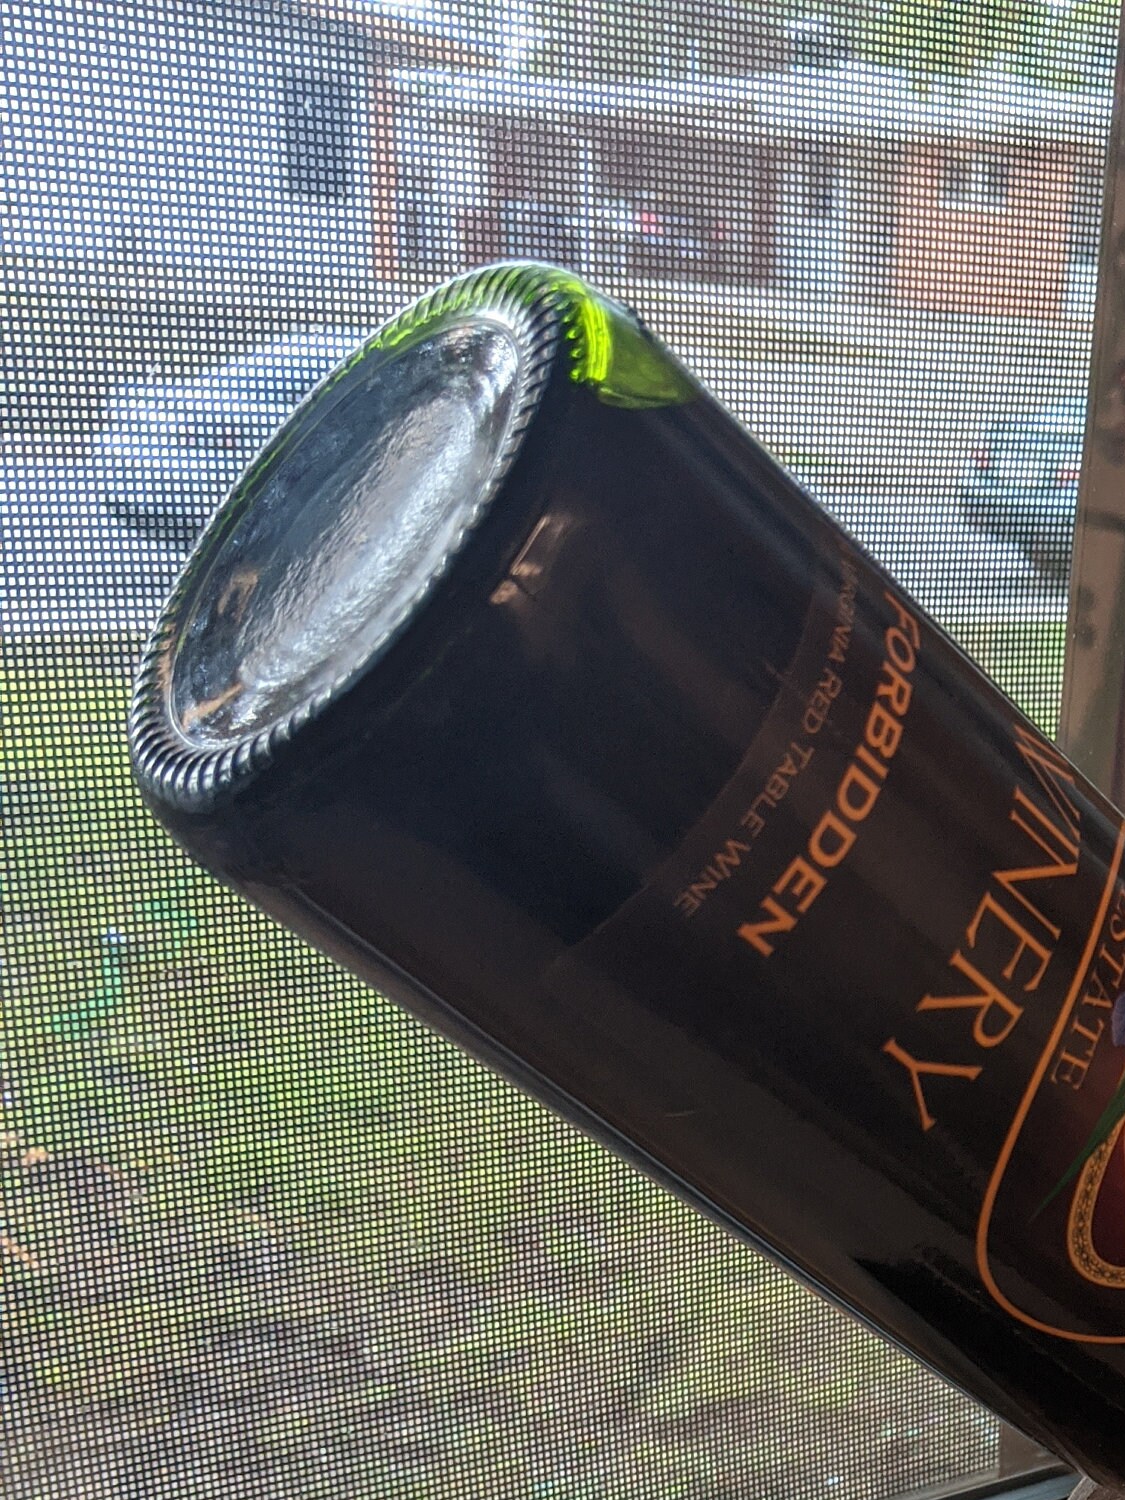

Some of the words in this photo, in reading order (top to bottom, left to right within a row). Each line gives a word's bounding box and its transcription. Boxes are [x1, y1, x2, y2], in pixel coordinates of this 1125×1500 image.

[803, 667, 843, 734] RED
[737, 591, 920, 957] FORBIDDEN
[742, 741, 814, 837] TABLE
[672, 839, 751, 917] WINE
[882, 725, 1080, 1131] WINERY
